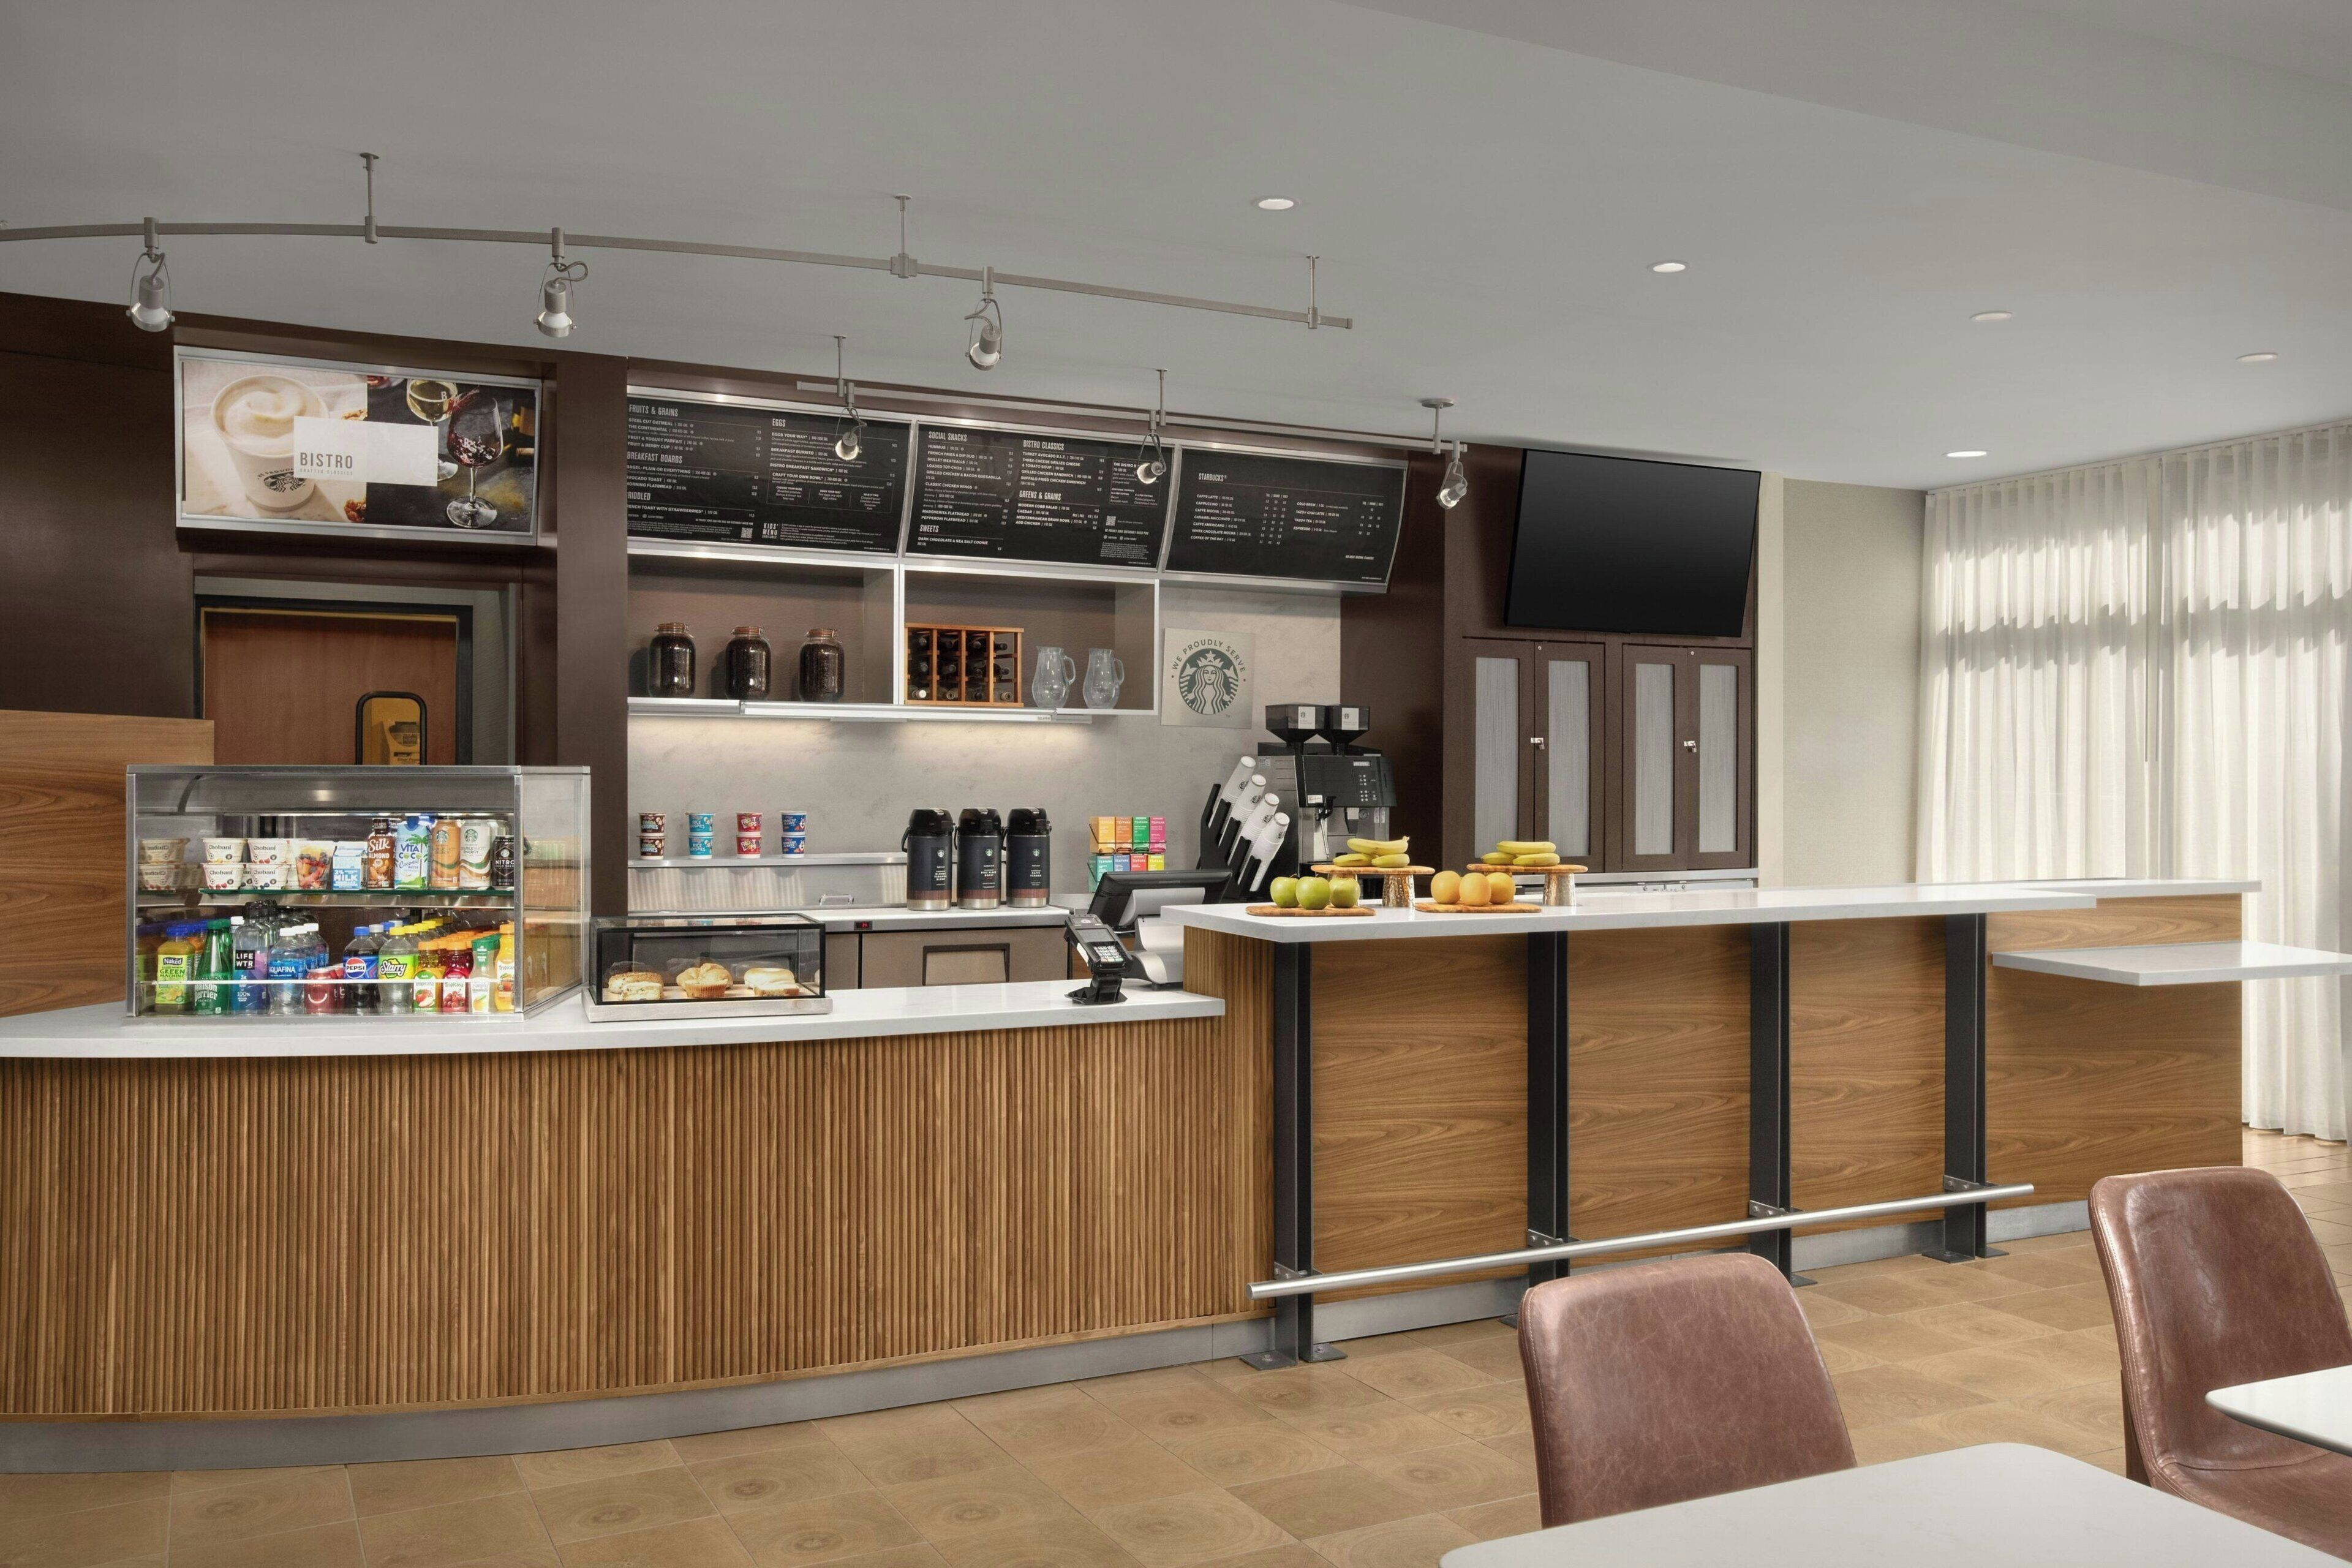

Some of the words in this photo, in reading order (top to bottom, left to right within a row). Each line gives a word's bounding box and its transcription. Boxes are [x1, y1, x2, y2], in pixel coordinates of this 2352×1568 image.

[629, 404, 649, 414] FRUITS
[658, 407, 678, 417] GRAINS
[772, 418, 786, 427] EGGS
[929, 431, 946, 440] SOCIAL
[948, 433, 967, 442] SNACKS
[1023, 440, 1039, 448] BISTRO
[1042, 442, 1064, 451] CLASSICS
[300, 453, 353, 469] BISTRO
[627, 451, 658, 461] BREAKFAST
[661, 454, 682, 463] BOARDS
[628, 491, 650, 500] RIDDLED
[1019, 490, 1037, 499] GREENS
[1172, 656, 1182, 670] WE
[1183, 639, 1223, 655] PROUDLY
[1226, 646, 1246, 673] SERVE
[369, 838, 390, 853] Silk
[401, 843, 419, 852] VITA
[380, 960, 407, 976] Starry
